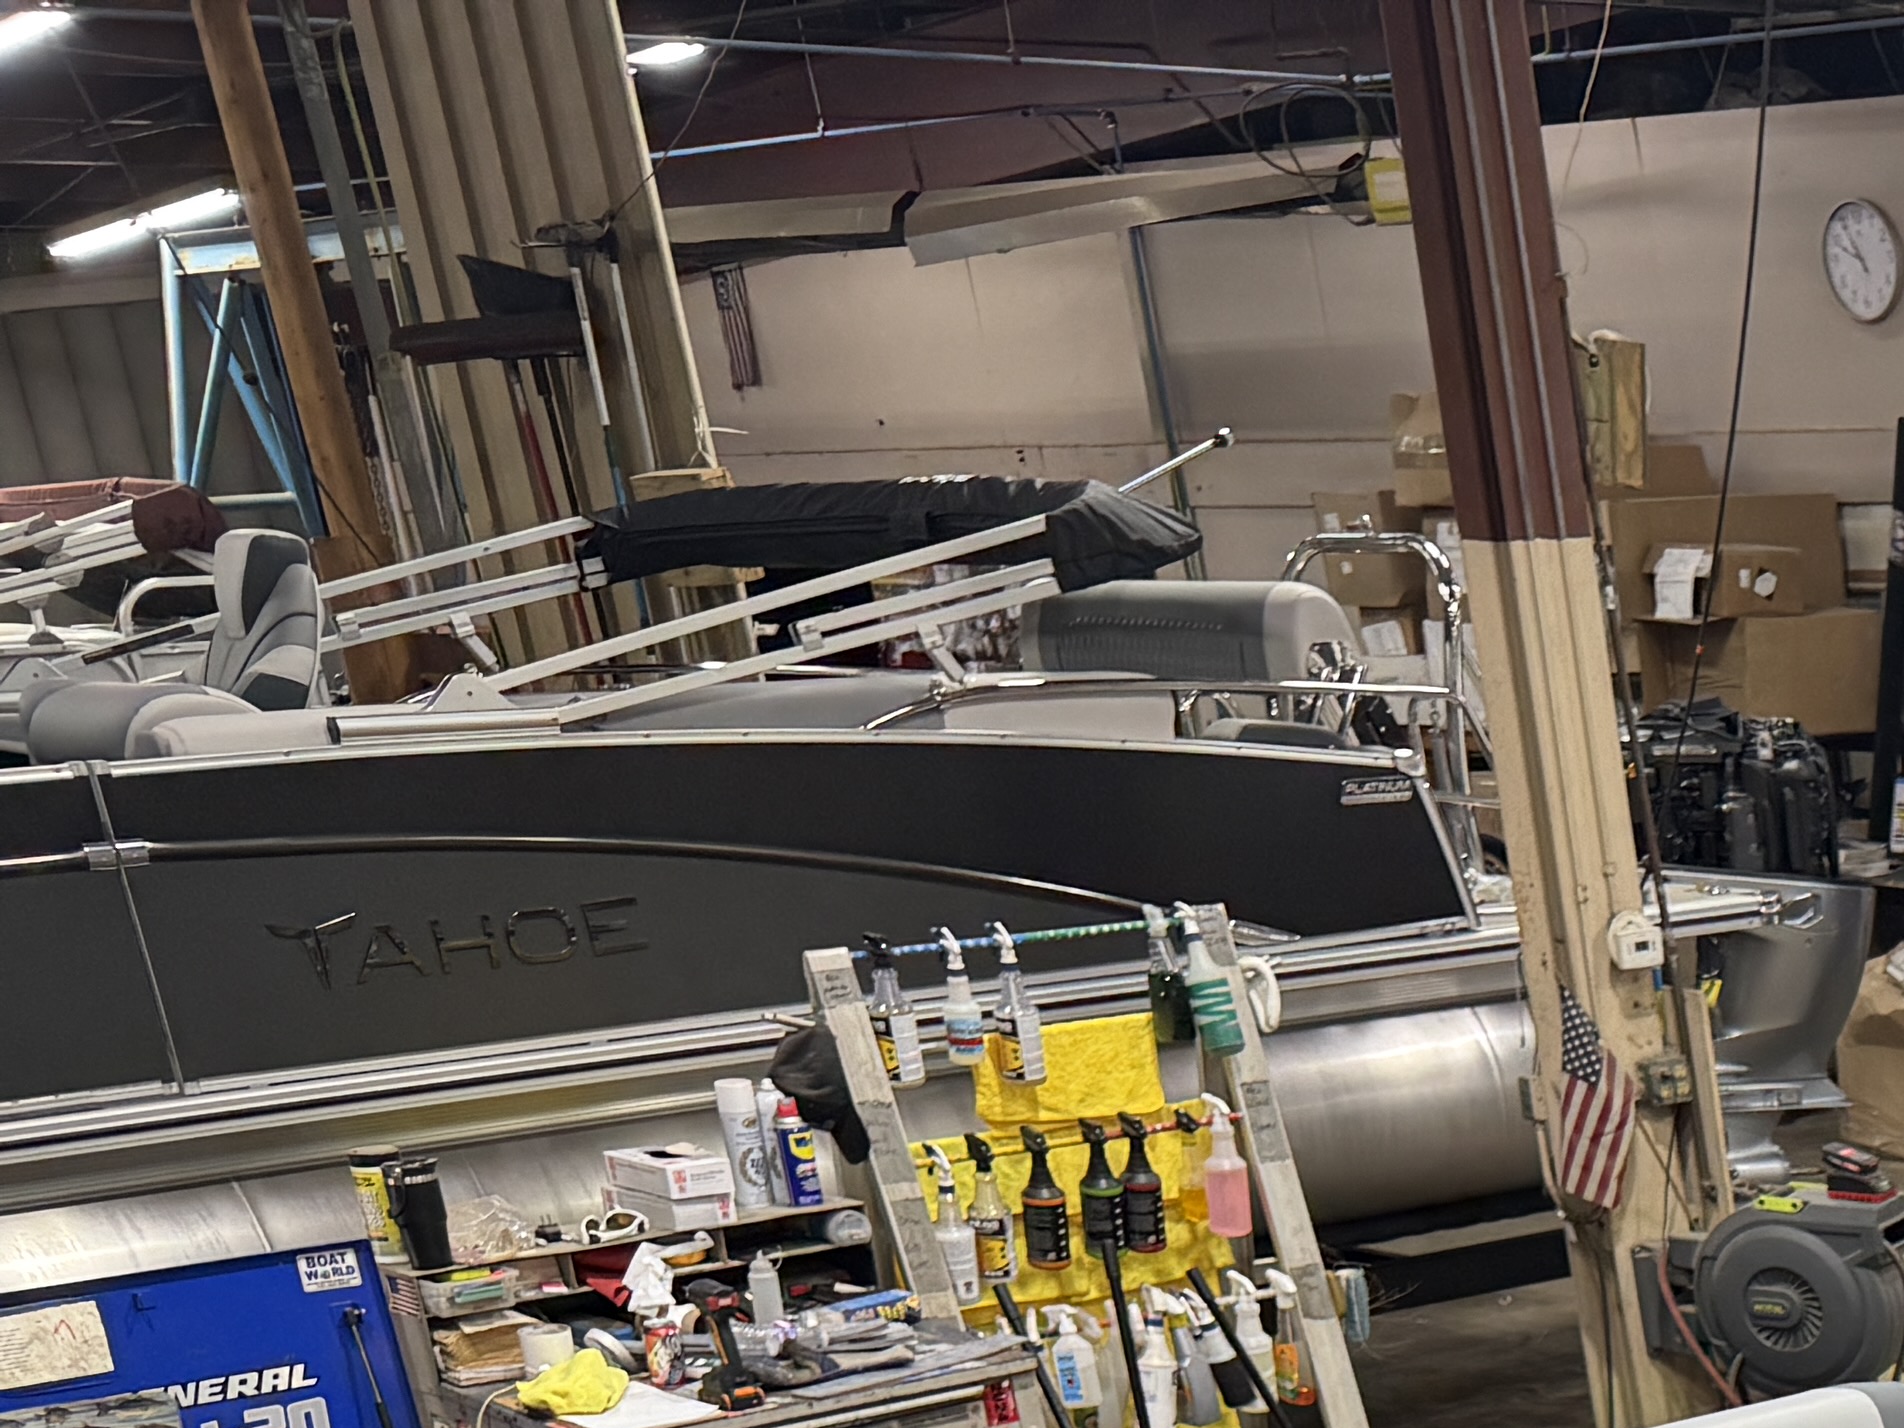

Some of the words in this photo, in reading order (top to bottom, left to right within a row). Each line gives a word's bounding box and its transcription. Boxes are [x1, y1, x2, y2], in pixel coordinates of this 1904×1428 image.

[264, 896, 649, 992] TAHOE
[304, 1251, 348, 1269] BOAT
[130, 1362, 319, 1408] NERAL
